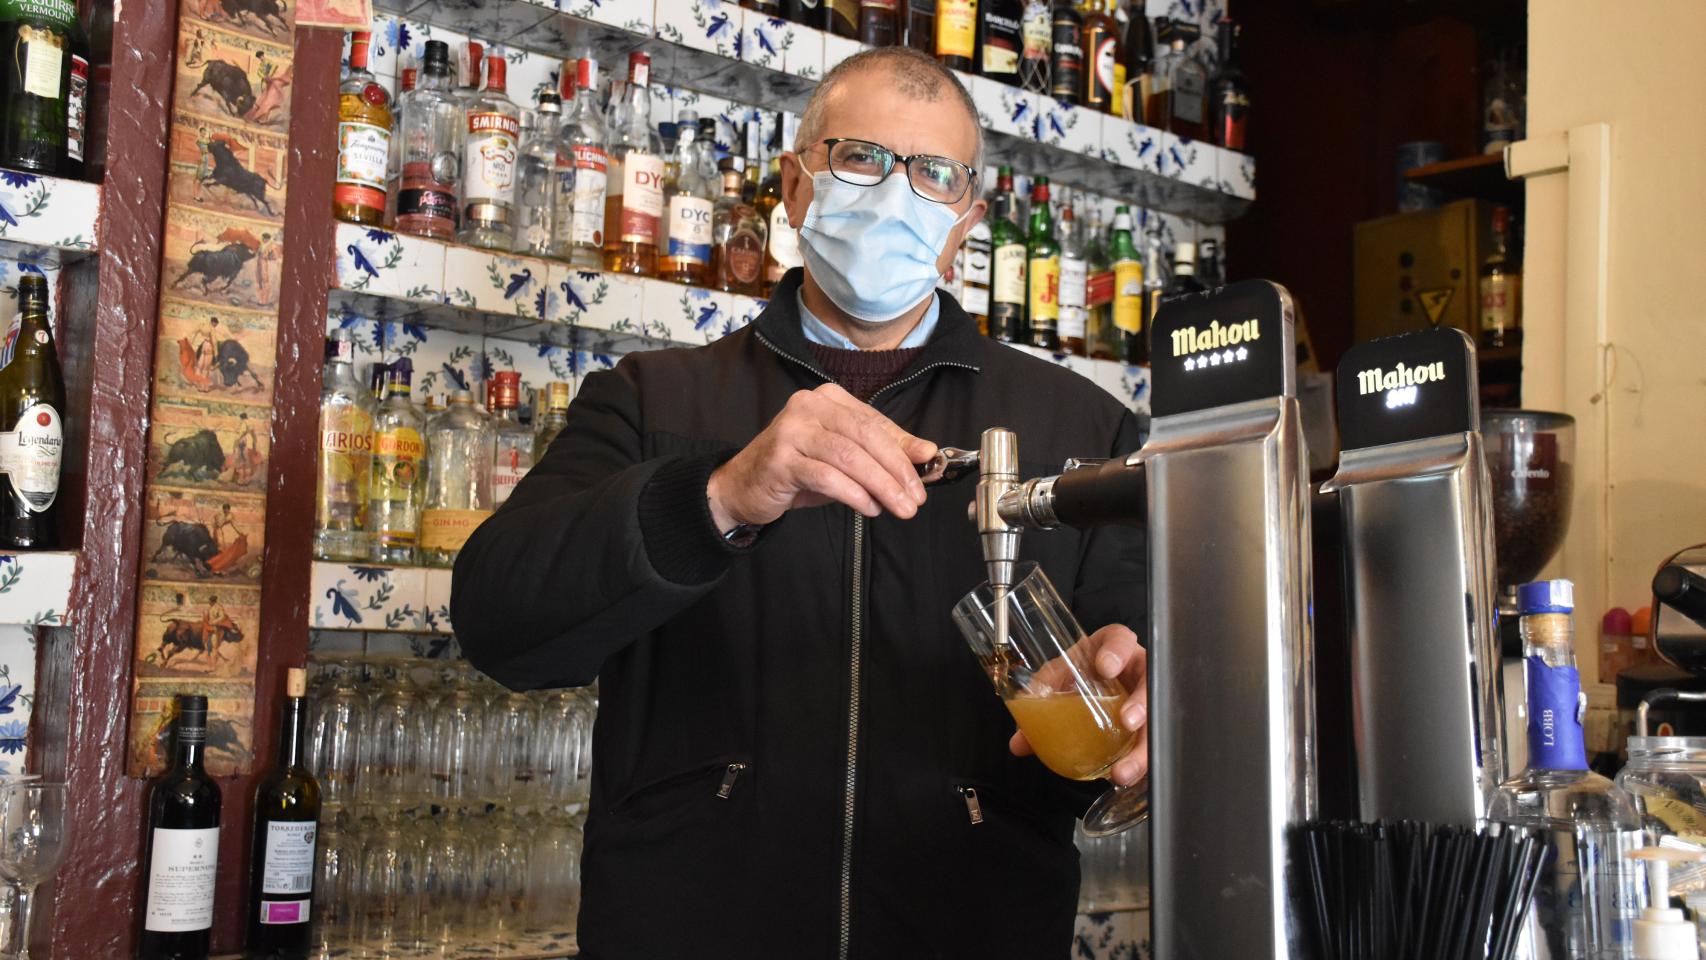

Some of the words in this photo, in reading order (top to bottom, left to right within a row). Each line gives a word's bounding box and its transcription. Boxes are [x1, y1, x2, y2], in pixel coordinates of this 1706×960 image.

[20, 3, 71, 23] VERMOUTH
[39, 331, 46, 343] 7
[1170, 319, 1260, 357] Mahou
[1357, 361, 1446, 395] Mahou
[321, 432, 372, 452] LARIOS
[1543, 709, 1554, 746] LOBB
